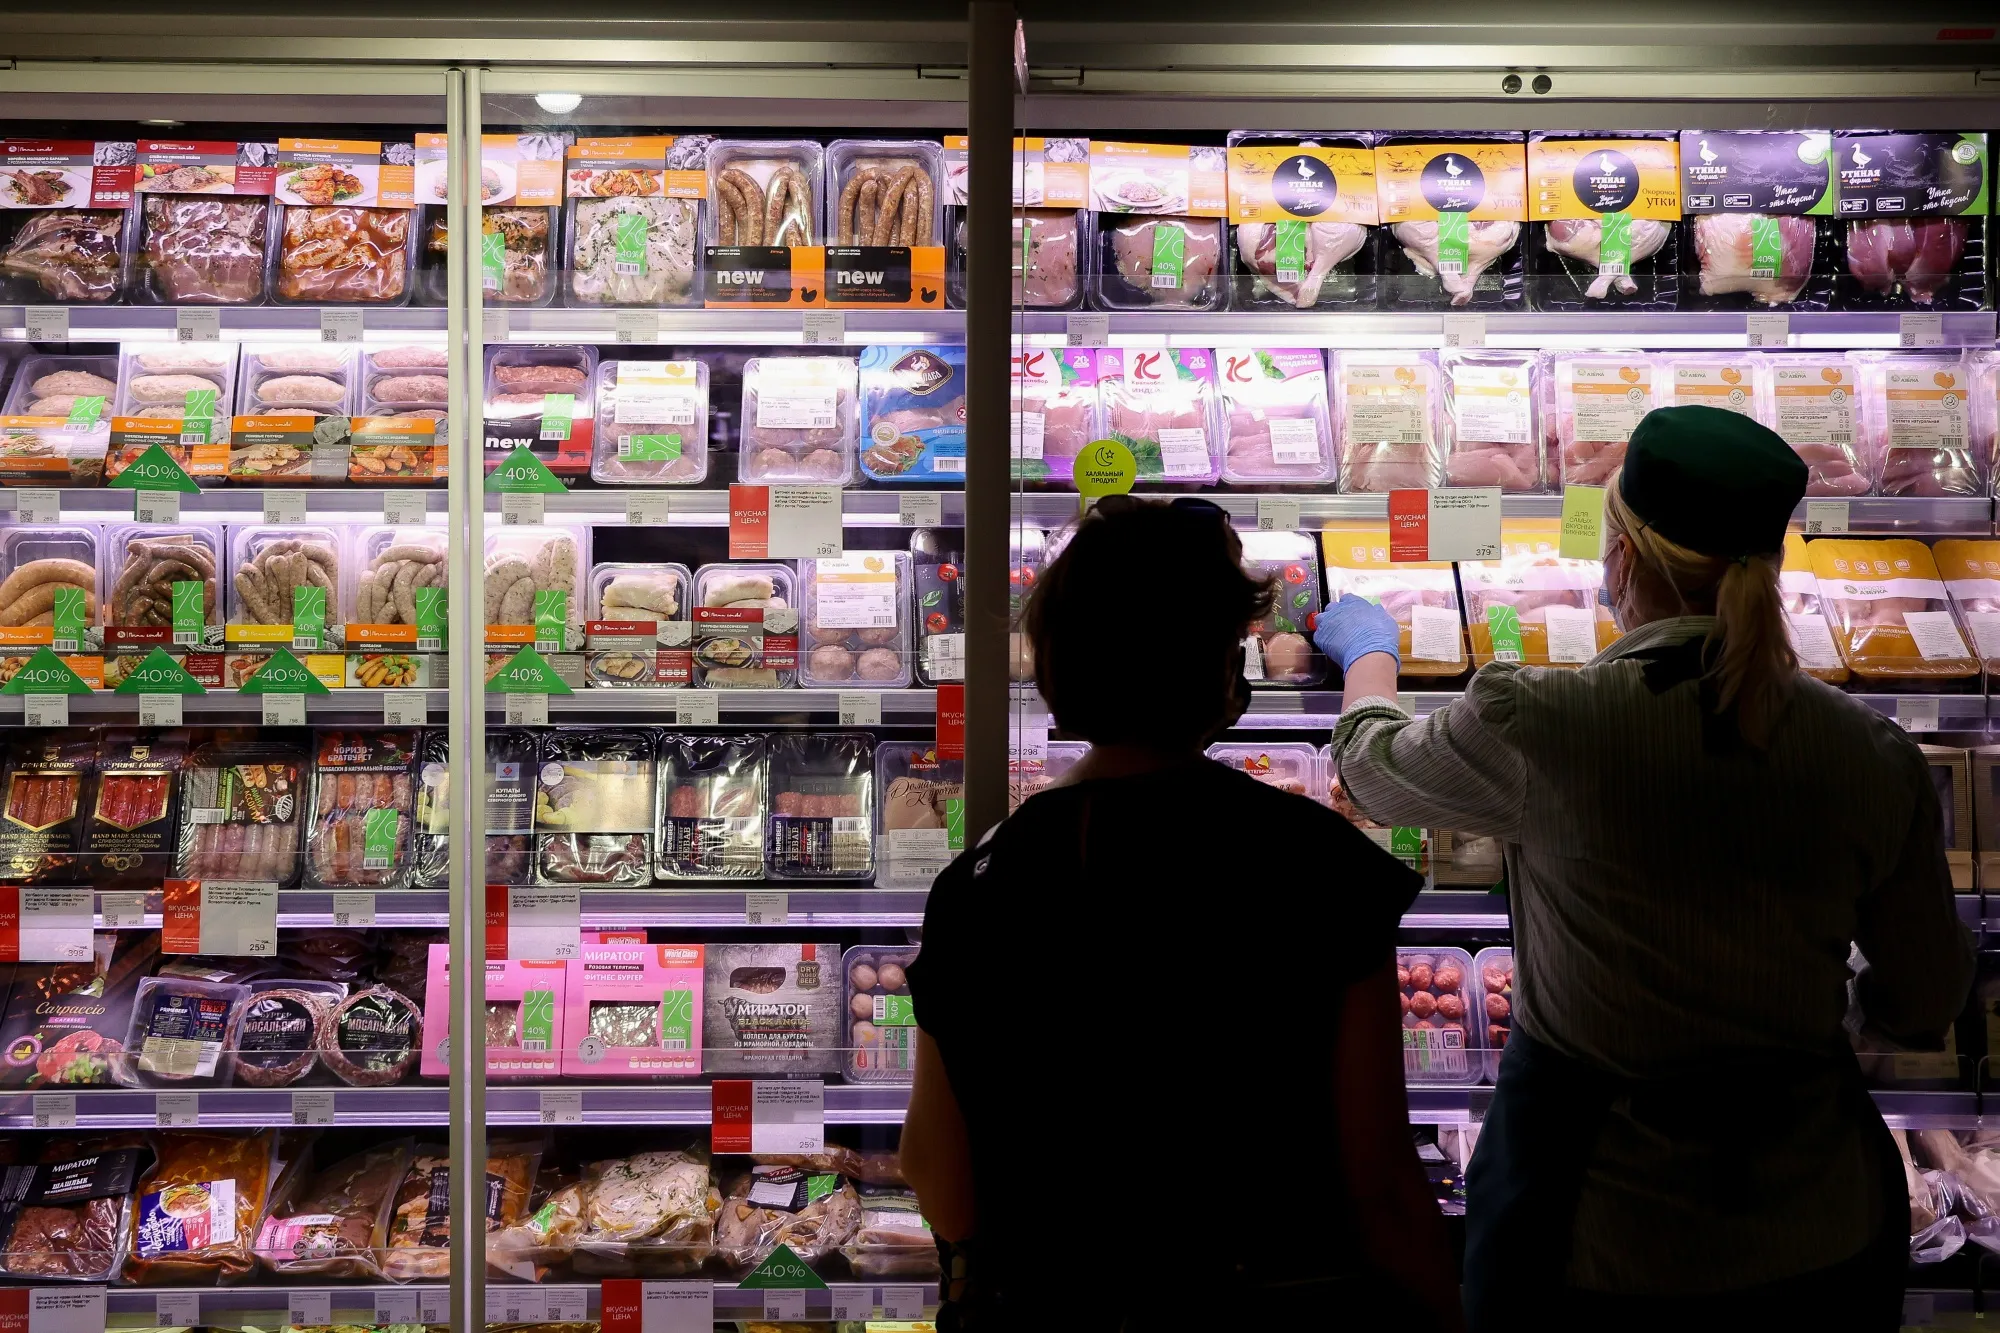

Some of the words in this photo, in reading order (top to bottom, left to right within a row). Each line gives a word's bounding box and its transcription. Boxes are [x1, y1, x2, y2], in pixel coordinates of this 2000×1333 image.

[1642, 188, 1677, 197] Окорочок
[1772, 184, 1799, 198] Утка
[1926, 188, 1952, 200] Утка
[1769, 200, 1786, 208] это
[1786, 188, 1816, 207] вкусно!
[1922, 202, 1938, 211] это
[1938, 189, 1970, 208] вкусно!
[1437, 248, 1462, 257] -40%
[1600, 250, 1624, 258] -40%
[717, 270, 765, 284] new
[838, 270, 884, 284] new
[182, 421, 206, 429] -40%
[484, 437, 534, 450] new
[127, 464, 180, 480] -40%
[1563, 528, 1596, 537] ПИКНИКОВ
[173, 618, 197, 626] -40%
[54, 626, 77, 634] -40%
[293, 624, 317, 632] -40%
[416, 624, 440, 632] -40%
[535, 628, 558, 636] -40%
[1492, 640, 1516, 648] -40%
[16, 668, 70, 684] -40%
[130, 668, 184, 684] -40%
[255, 668, 308, 682] -40%
[906, 786, 960, 806] Курочка
[1390, 844, 1415, 852] -40%
[174, 912, 194, 920] ЦЕНА
[248, 944, 266, 952] 259
[555, 948, 571, 956] 379
[584, 951, 644, 962] МИРАТОРГ
[664, 949, 680, 958] World
[800, 965, 816, 973] DRY
[35, 1001, 106, 1016] Carpaccio
[737, 1002, 812, 1016] МИРАТОРГ
[244, 1018, 306, 1033] МОСАЛЬСКИЙ
[522, 1026, 546, 1034] -40%
[662, 1026, 686, 1034] -40%
[52, 1156, 100, 1173] МИРАТОРГ
[52, 1176, 89, 1190] ШАШЛЫК
[754, 1264, 806, 1278] -40%
[606, 1306, 638, 1314] ВКУСНАЯ
